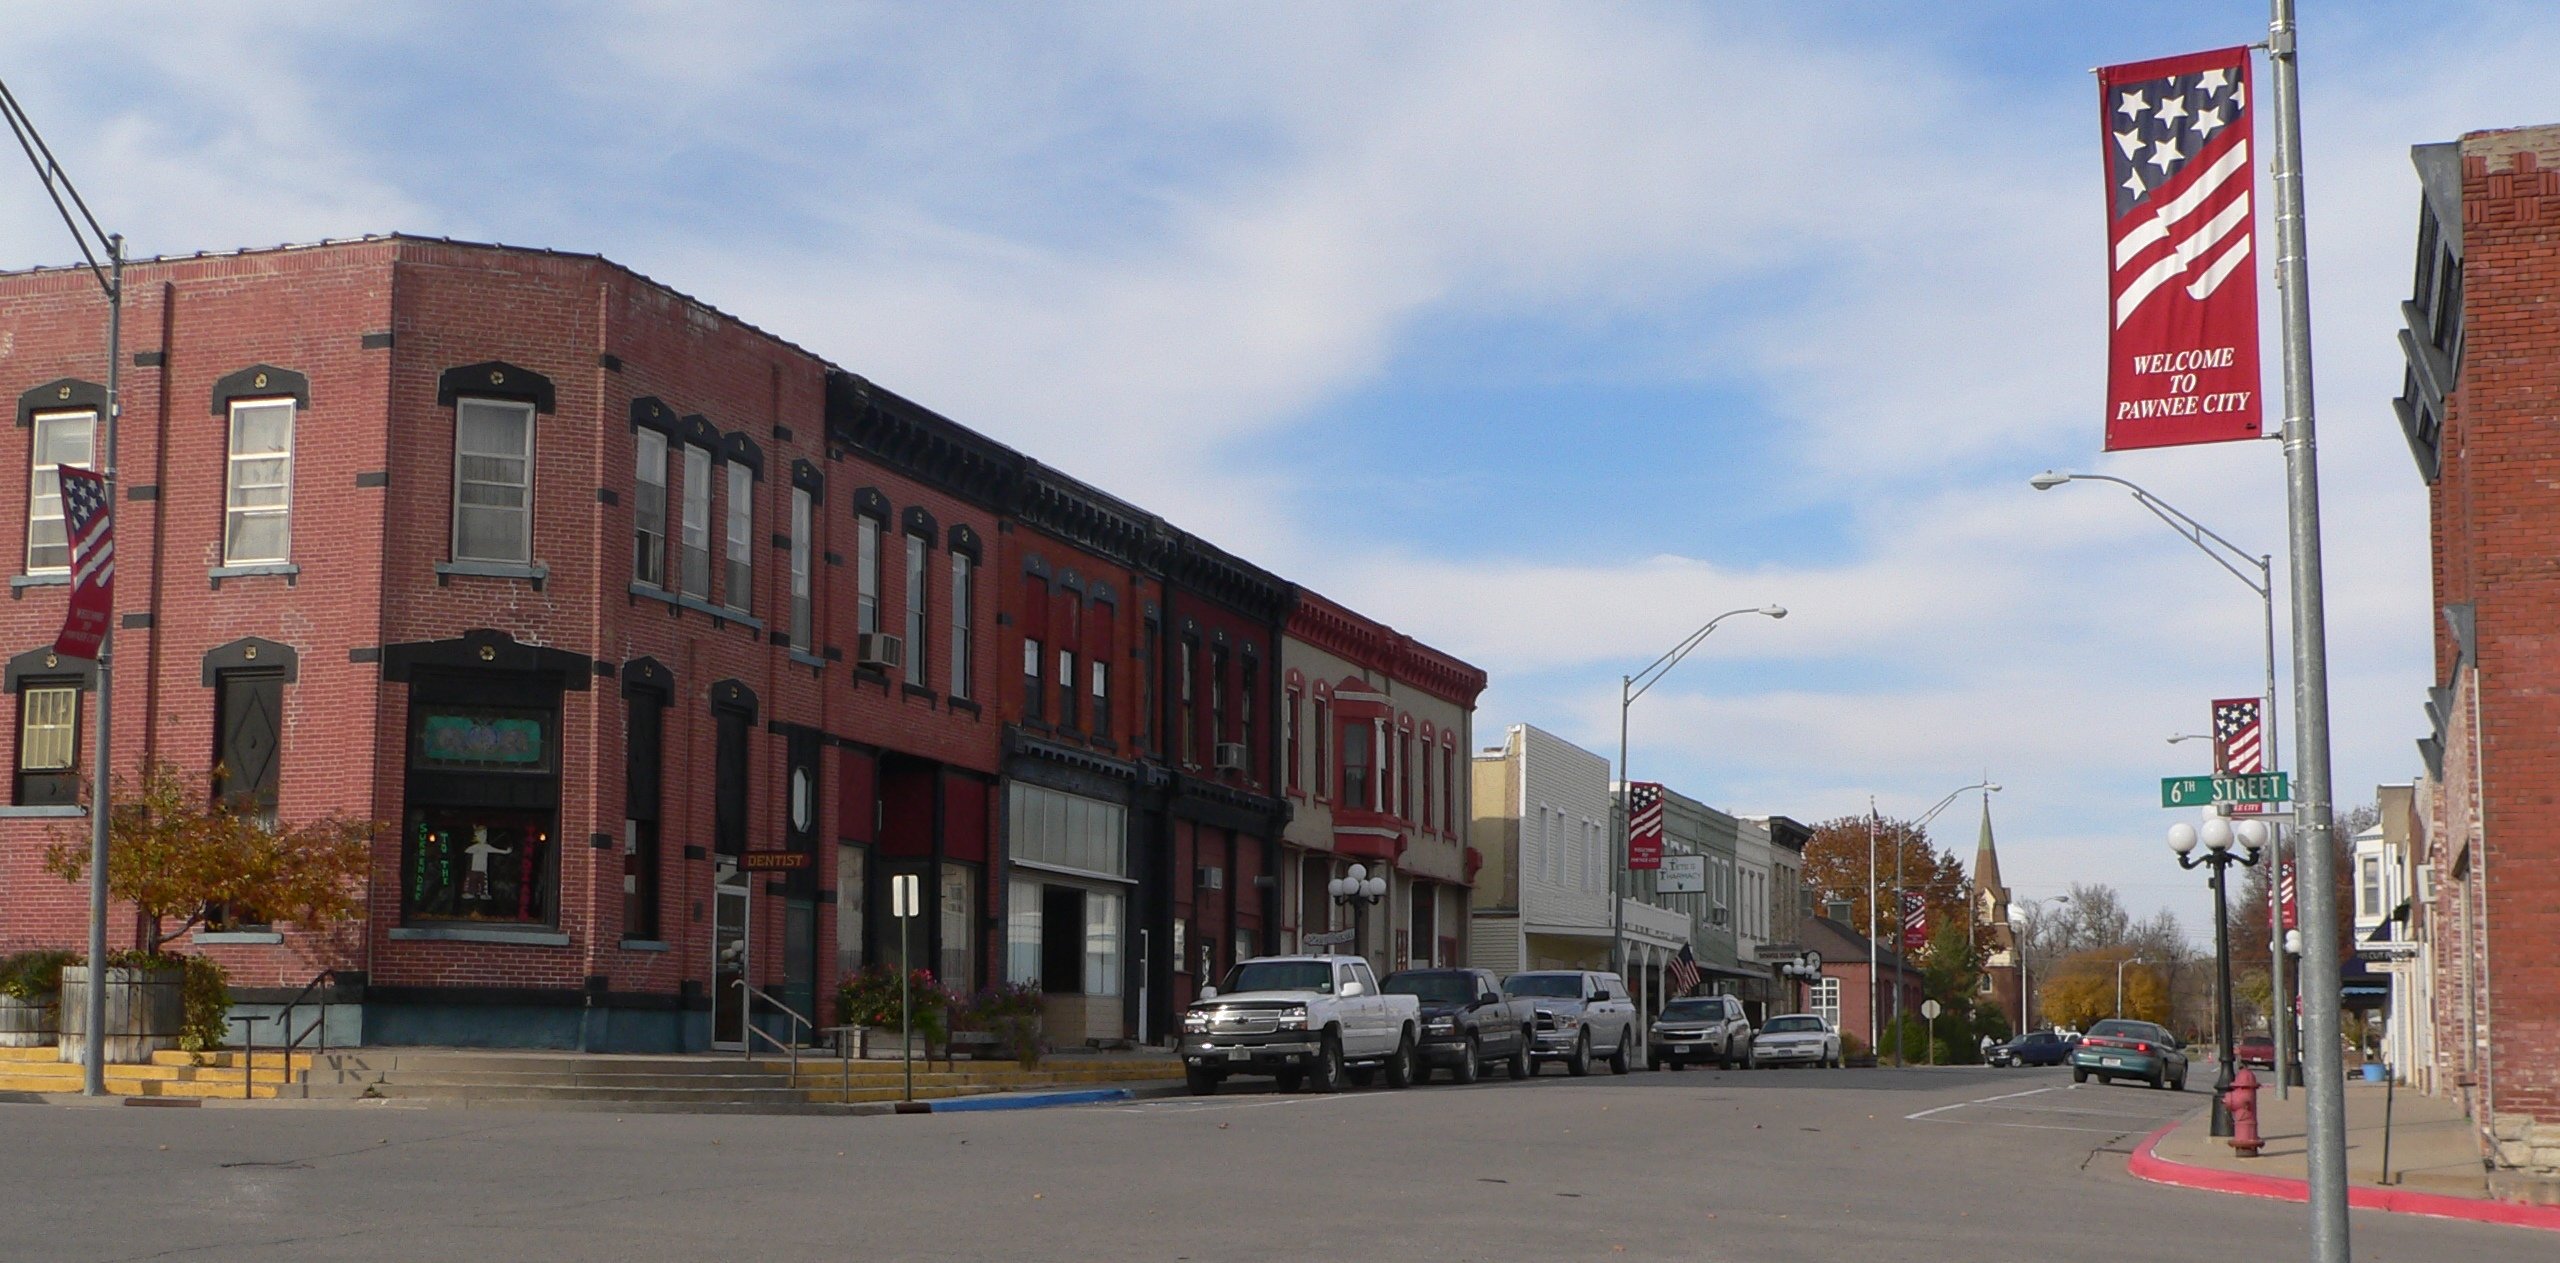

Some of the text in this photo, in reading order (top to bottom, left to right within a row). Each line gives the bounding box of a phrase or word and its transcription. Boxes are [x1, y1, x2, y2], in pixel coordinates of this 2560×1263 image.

[2133, 347, 2235, 375] WELCOME
[2170, 373, 2197, 394] TO
[2116, 392, 2251, 420] PAWNEE CITY
[2171, 776, 2279, 803] 6TH STREET
[440, 832, 449, 853] TO
[748, 854, 803, 867] DENTIST
